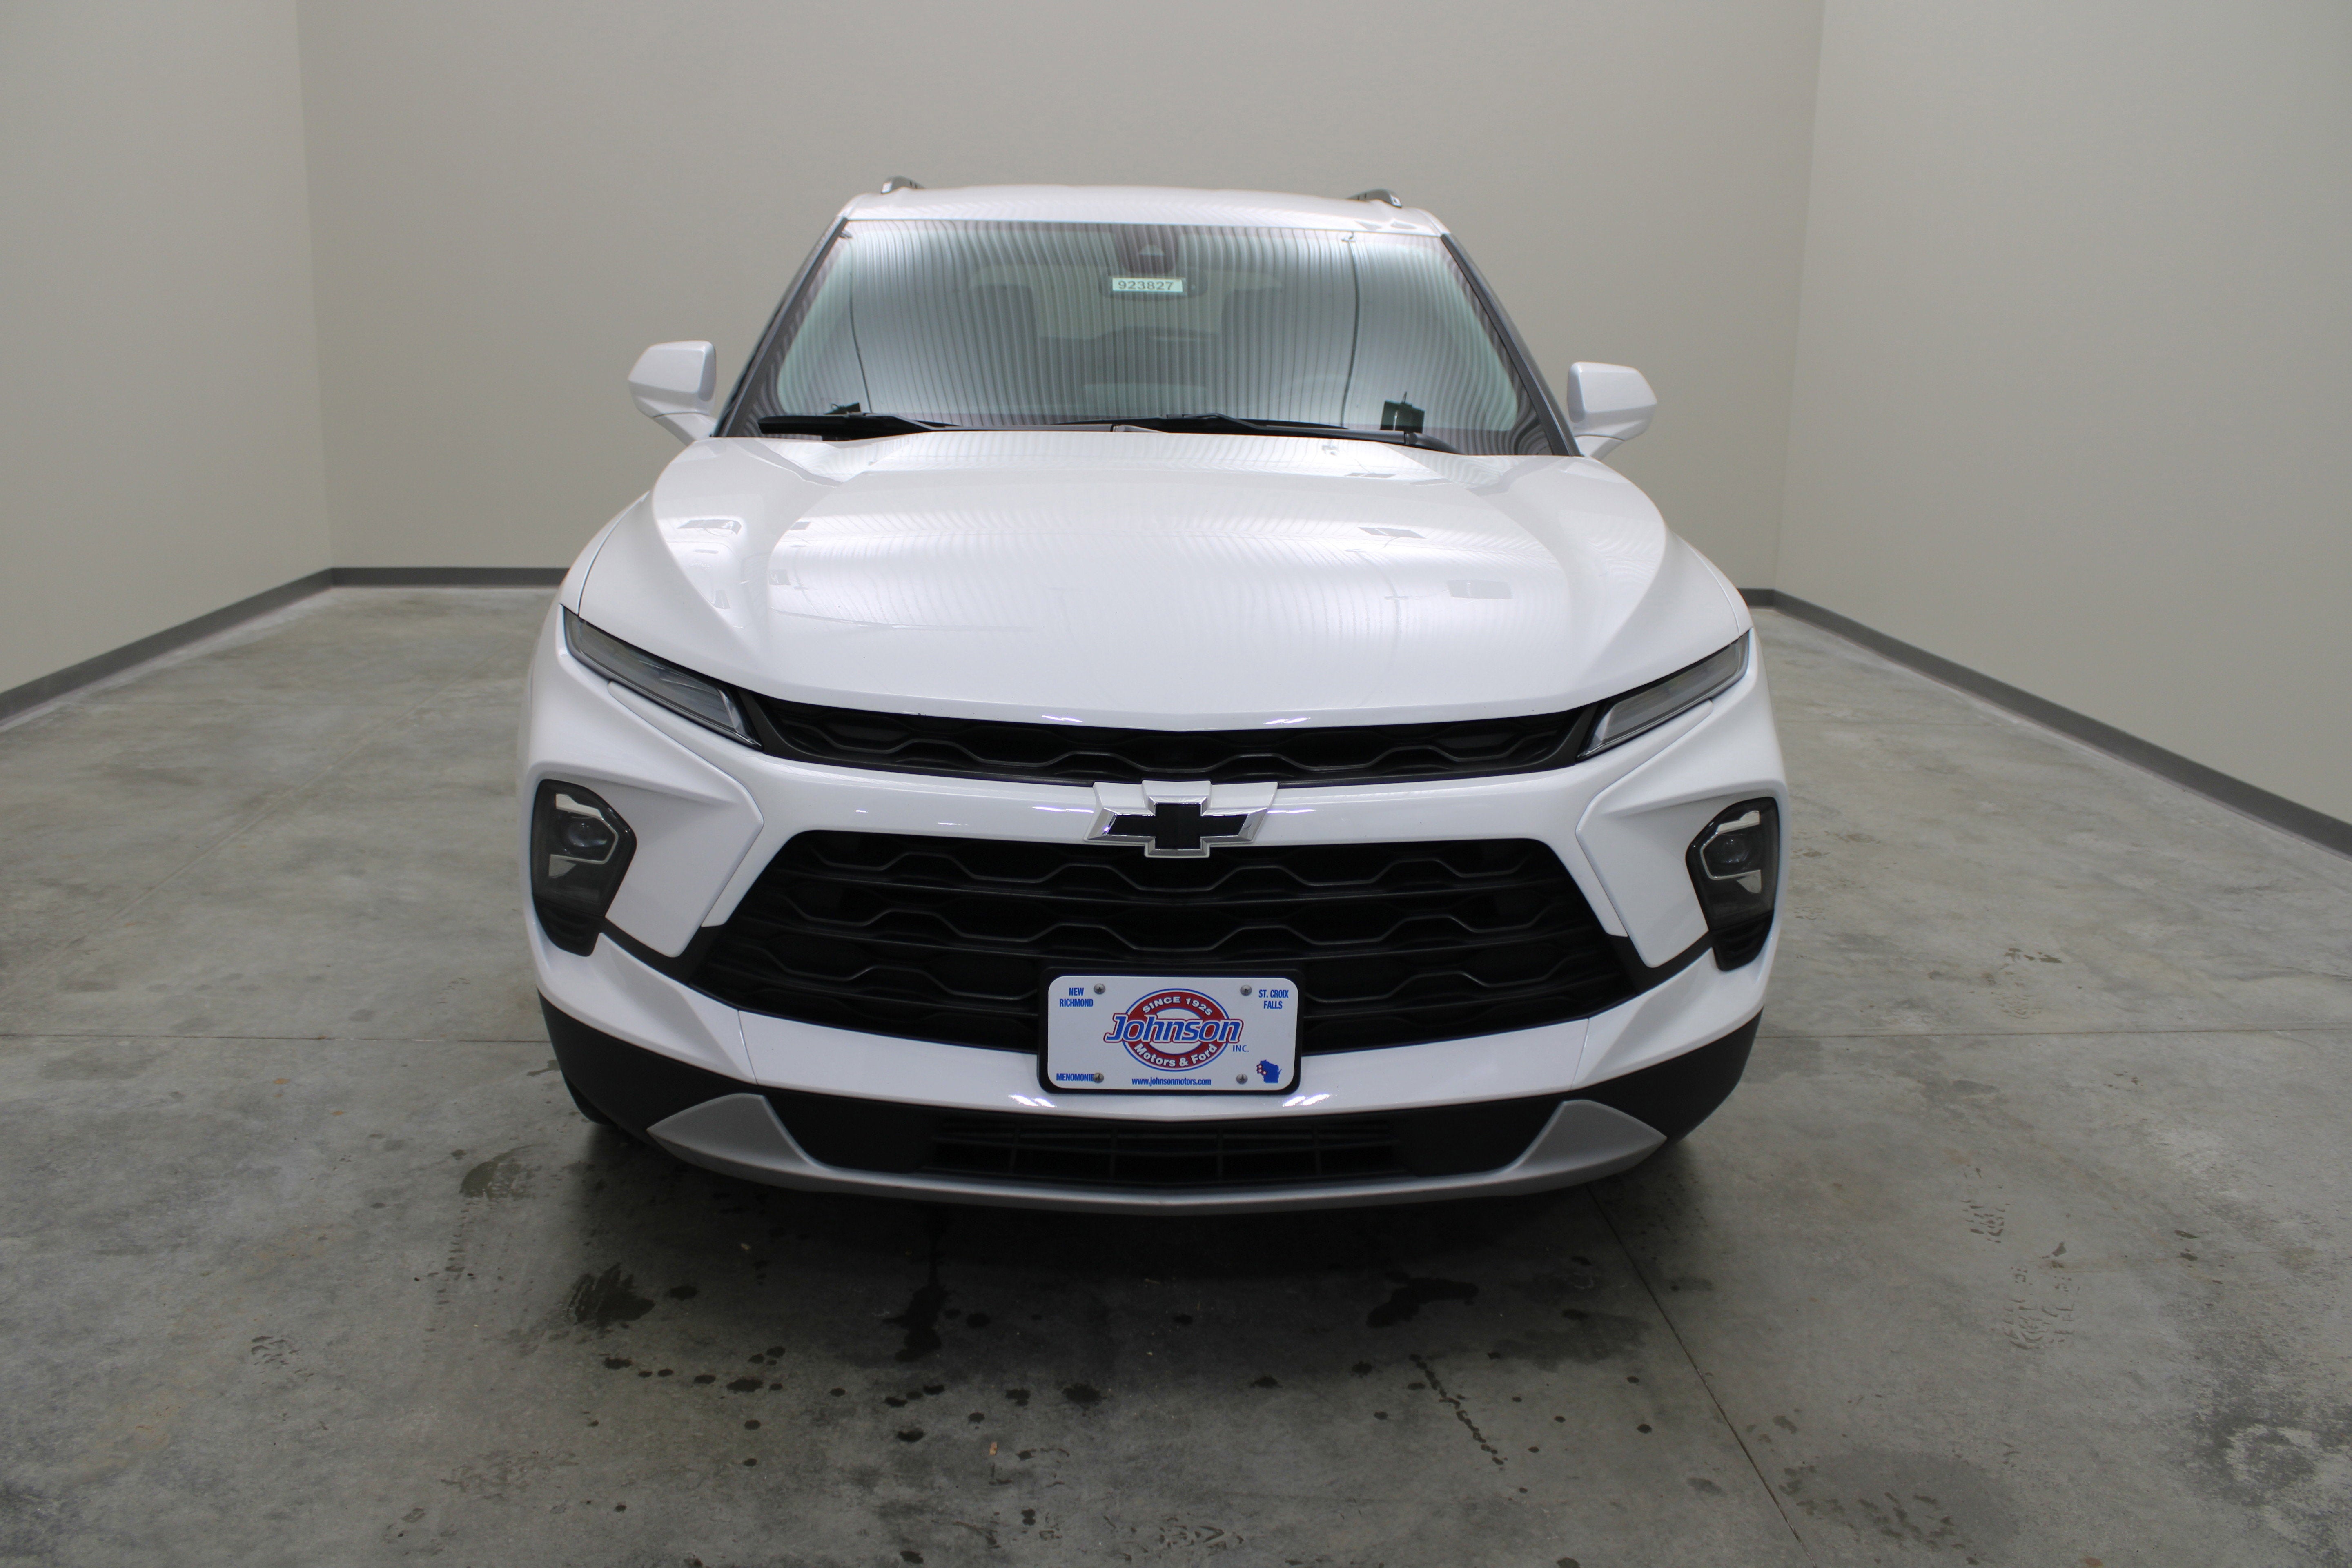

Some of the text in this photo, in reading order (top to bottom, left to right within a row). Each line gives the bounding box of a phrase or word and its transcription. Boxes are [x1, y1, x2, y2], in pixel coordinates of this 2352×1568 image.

[1118, 281, 1174, 290] 923827
[1069, 987, 1084, 996] NEW
[1258, 989, 1289, 998] ST. CROIX
[1059, 999, 1094, 1007] RICHMOND
[1142, 996, 1213, 1016] SINCE 1925
[1263, 1000, 1283, 1009] FALLS
[1104, 1013, 1244, 1044] Johnson
[1134, 1043, 1218, 1067] Motors & Ford
[1131, 1077, 1212, 1086] www.johnsonmotors.com
